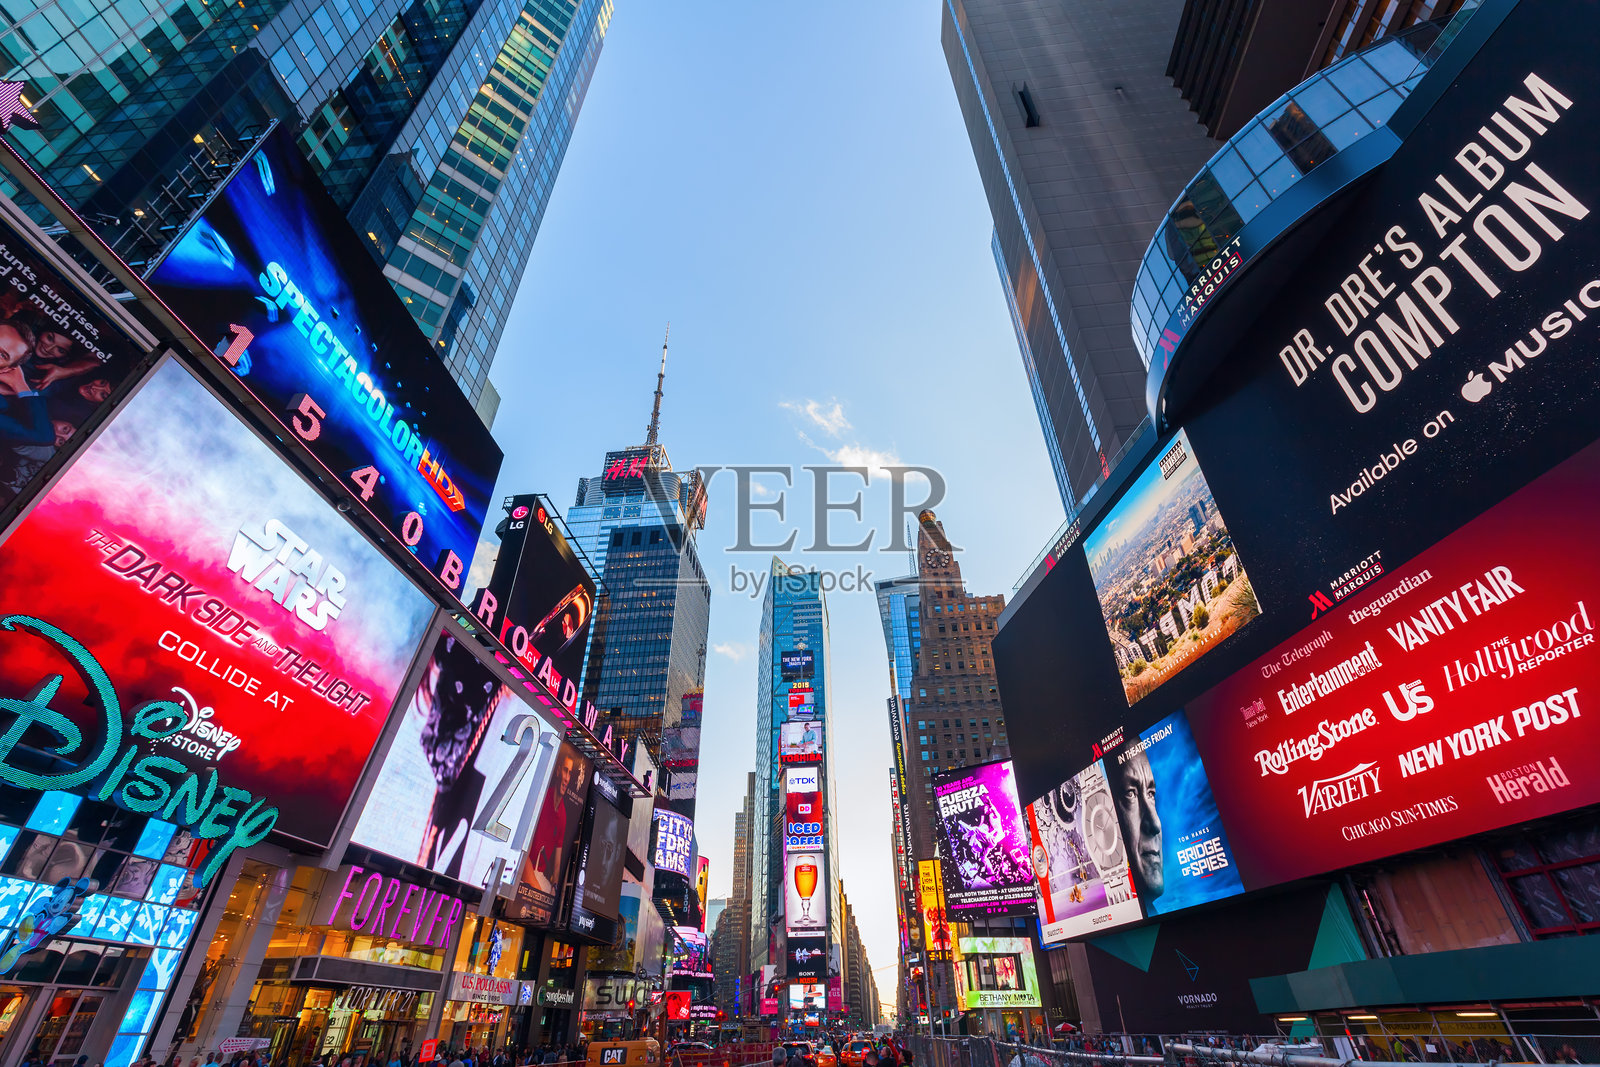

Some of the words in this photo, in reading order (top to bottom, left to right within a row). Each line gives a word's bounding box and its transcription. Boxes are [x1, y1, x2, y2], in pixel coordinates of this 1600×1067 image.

[1279, 328, 1334, 386] DR.
[1324, 225, 1424, 336] DRE'S
[1418, 72, 1573, 239] ALBUM
[1177, 236, 1243, 317] MARRIOTT
[1181, 252, 1243, 327] MARQUIS
[1331, 162, 1590, 414] COMPTON
[10, 275, 28, 293] so
[29, 290, 70, 330] much
[71, 329, 113, 364] more!
[41, 283, 99, 340] surprises,
[1488, 279, 1600, 384] MUSIC
[259, 262, 424, 470] SPECTACOLOR
[1330, 439, 1418, 516] Available
[1423, 410, 1455, 439] on
[85, 529, 122, 556] THE
[509, 521, 524, 529] LG
[1055, 518, 1080, 552] MARRIOTT
[1057, 530, 1080, 560] MARQUIS
[102, 544, 206, 614] DARK
[239, 519, 347, 603] STAR
[1330, 550, 1382, 590] MARRIOTT
[227, 533, 342, 632] WARS
[1334, 563, 1384, 601] MARQUIS
[192, 599, 259, 647] SIDE
[1387, 590, 1468, 652] VANITY
[1460, 566, 1526, 616] FAIR
[252, 637, 279, 658] AND
[1261, 663, 1281, 679] The
[1282, 630, 1334, 666] Telegraph
[1442, 601, 1596, 692] Hollywood
[1491, 636, 1510, 649] THE
[1517, 633, 1595, 673] REPORTER
[158, 631, 262, 696] COLLIDE
[264, 690, 295, 713] AT
[1277, 641, 1383, 715] Entertainment
[1382, 682, 1434, 722] Us
[173, 734, 215, 761] STORE
[1101, 726, 1124, 745] MARRIOTT
[1103, 736, 1124, 753] MARQUIS
[1117, 753, 1126, 764] IN
[1124, 738, 1151, 760] THEATRES
[1151, 724, 1173, 746] FRIDAY
[1398, 740, 1443, 778] NEW
[1445, 715, 1511, 761] YORK
[1511, 687, 1582, 738] POST
[782, 753, 822, 762] TOSHIBA
[1500, 762, 1537, 781] BOSTON
[472, 714, 562, 852] 21
[939, 784, 989, 808] FUERZA
[1296, 760, 1383, 819] VARIETY
[1486, 756, 1571, 804] Herald
[941, 797, 984, 818] BRUTA
[789, 823, 821, 834] ICED
[903, 804, 913, 856] Newswire
[1179, 835, 1190, 843] TOM
[1191, 827, 1210, 838] HANKS
[1342, 816, 1391, 842] CHICAGO
[1177, 837, 1224, 865] BRIDGE
[1182, 866, 1191, 876] OF
[1190, 853, 1229, 877] SPIES
[328, 865, 462, 949] FOREVER
[922, 883, 935, 893] KING
[348, 986, 401, 1012] FOREVER
[400, 991, 416, 1012] 21
[462, 976, 474, 989] U.S.
[476, 977, 493, 992] POLO
[494, 980, 512, 994] ASSN.
[979, 994, 1011, 1002] BETHANY
[1178, 992, 1217, 1005] VORNADO
[604, 1049, 623, 1064] CAT
